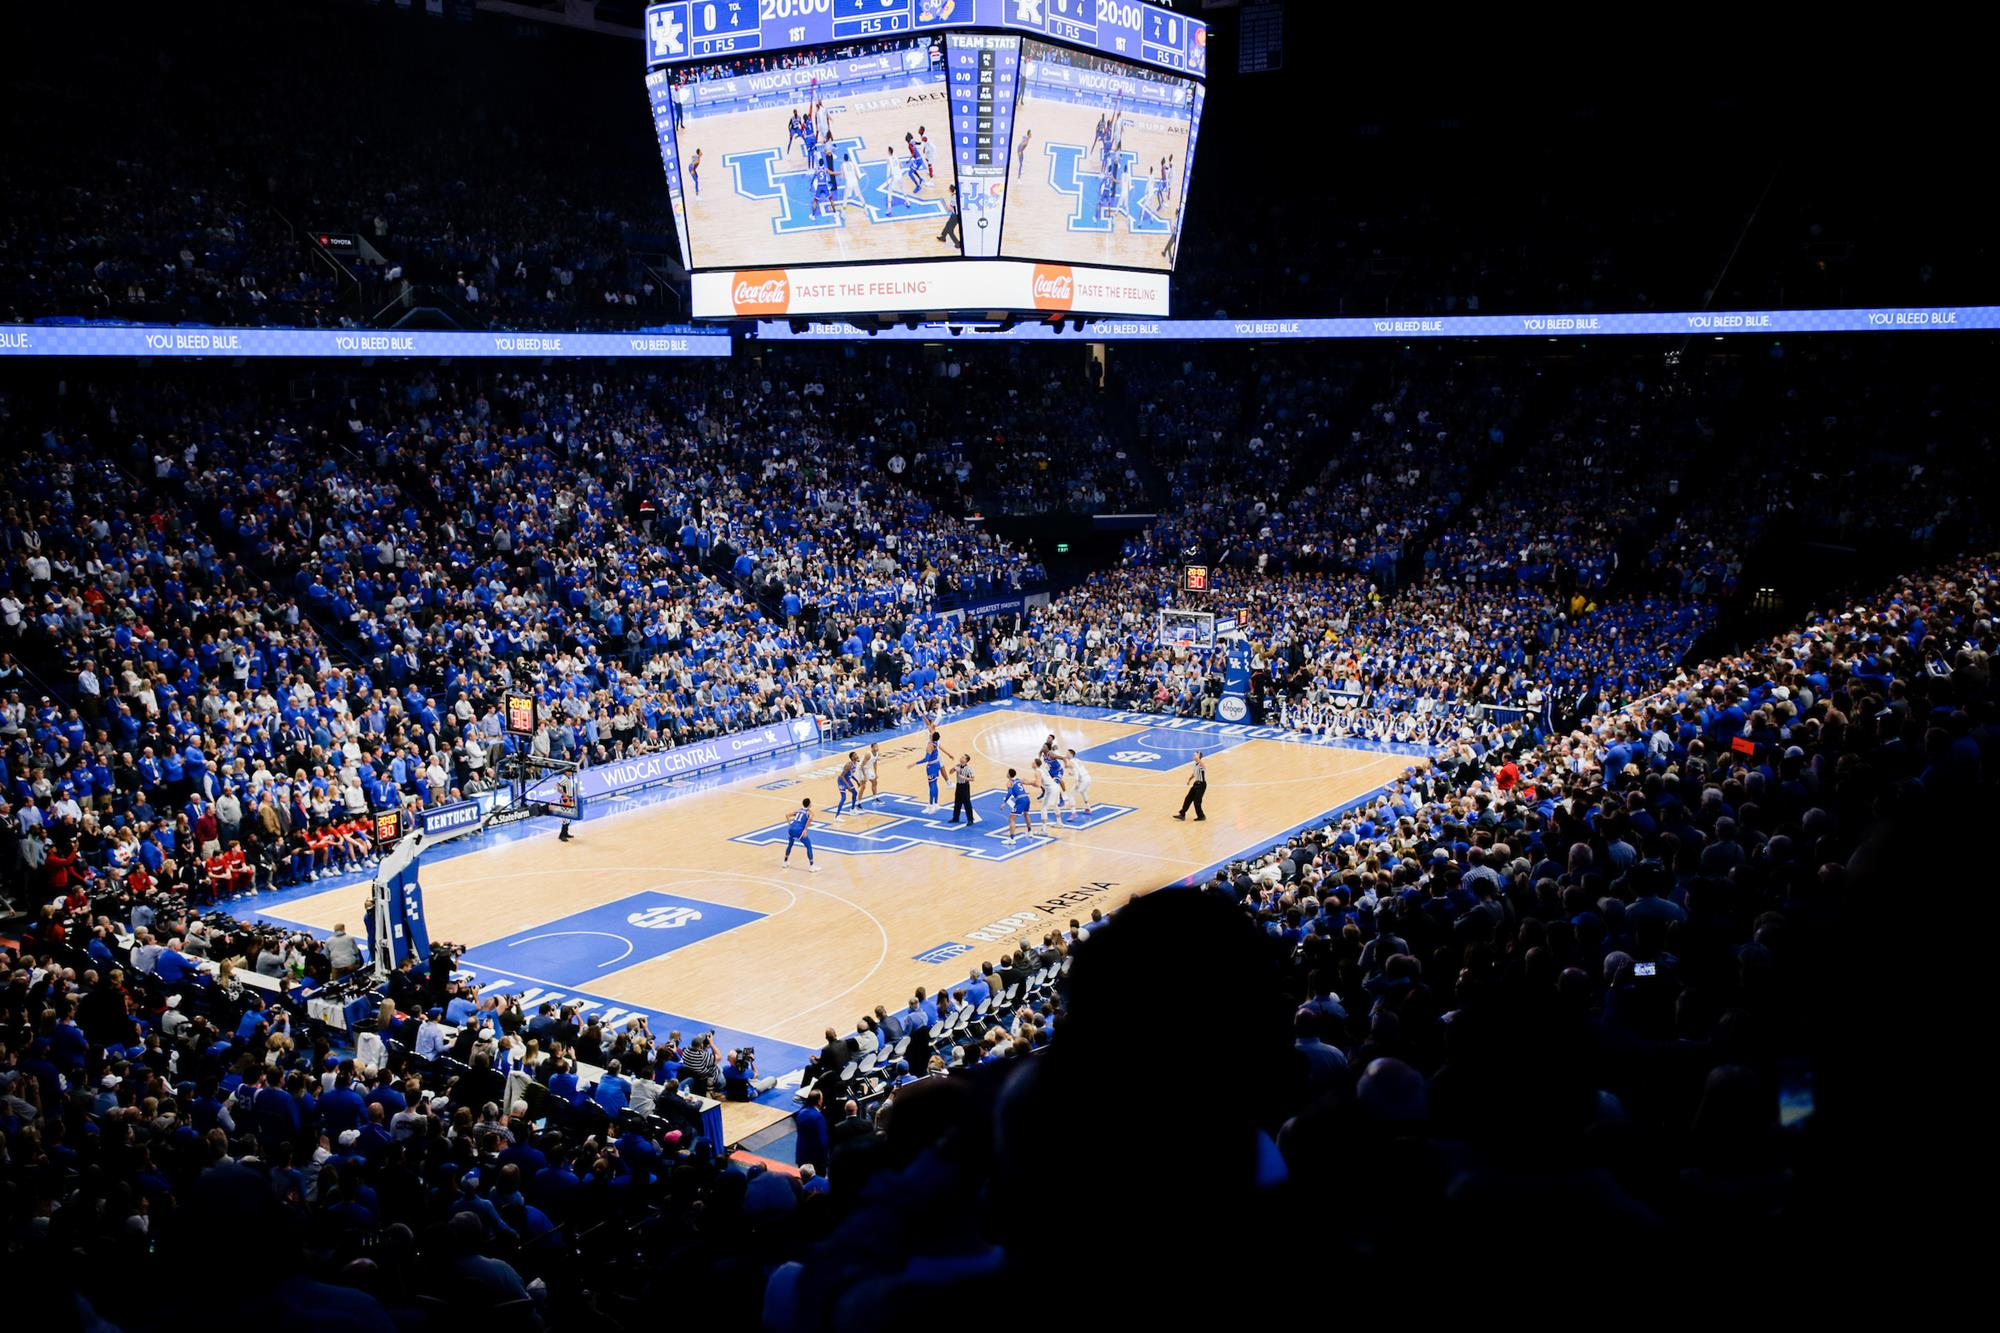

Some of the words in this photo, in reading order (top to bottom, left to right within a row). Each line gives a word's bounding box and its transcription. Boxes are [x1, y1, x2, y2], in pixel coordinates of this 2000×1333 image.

[728, 3, 741, 11] TOL
[760, 0, 829, 21] 20:00
[1077, 2, 1083, 17] 4
[703, 4, 717, 31] 0
[730, 12, 739, 27] 4
[1099, 4, 1141, 31] 20:00
[861, 19, 881, 33] FLS
[891, 16, 899, 29] 0
[1057, 22, 1062, 34] 0
[1066, 25, 1079, 38] FLS
[788, 27, 805, 42] 1ST
[1155, 26, 1160, 39] 4
[1168, 18, 1177, 45] 0
[703, 41, 710, 53] 0
[716, 38, 735, 52] FLS
[951, 36, 983, 48] TEAM
[986, 37, 1016, 49] STATS
[1157, 51, 1169, 64] FLS
[1174, 54, 1178, 66] 0
[749, 73, 792, 91] WILDCAT
[794, 66, 839, 85] CENTRAL
[1079, 73, 1107, 88] WILDCAT
[962, 105, 968, 113] 0
[1001, 106, 1006, 114] 0
[962, 121, 968, 129] 0
[1000, 121, 1005, 129] 0
[962, 136, 968, 144] 0
[1000, 136, 1004, 144] 0
[963, 152, 968, 160] 0
[999, 152, 1004, 160] 0
[796, 285, 835, 298] TASTE
[840, 284, 865, 296] THE
[869, 281, 927, 295] FEELING
[1077, 284, 1103, 298] TASTE
[1105, 286, 1122, 298] THE
[1123, 288, 1156, 300] FEELING
[1524, 320, 1545, 329] YOU
[1548, 319, 1574, 329] BLEED
[1576, 318, 1600, 329] BLUE.
[1688, 317, 1711, 327] YOU
[1714, 317, 1742, 327] BLEED
[1746, 316, 1772, 326] BLUE.
[1869, 313, 1893, 324] YOU
[1897, 313, 1929, 324] BLEED
[816, 324, 841, 334] BLEED
[1092, 325, 1111, 334] YOU
[1113, 325, 1138, 334] BLEED
[1235, 324, 1254, 333] YOU
[1256, 323, 1278, 333] BLEED
[1374, 322, 1393, 331] YOU
[1395, 322, 1420, 331] BLEED
[1422, 321, 1443, 331] BLUE.
[146, 335, 173, 348] YOU
[177, 335, 209, 348] BLEED
[213, 336, 241, 348] BLUE.
[336, 337, 358, 349] YOU
[361, 337, 389, 349] BLEED
[391, 337, 415, 349] BLUE.
[495, 338, 514, 350] YOU
[516, 339, 540, 350] BLEED
[631, 339, 647, 350] YOU
[649, 340, 669, 350] BLEED
[1187, 568, 1206, 576] 20:00
[1190, 576, 1204, 588] 30
[1222, 701, 1243, 717] Kroger
[1108, 751, 1161, 763] SEC
[602, 759, 662, 787] WILDCAT
[665, 745, 721, 777] CENTRAL
[378, 814, 397, 827] 20:00
[427, 807, 479, 831] KENTUCKY
[381, 825, 395, 838] 30
[1033, 882, 1121, 915] ARENA
[965, 911, 1041, 942] RUPP
